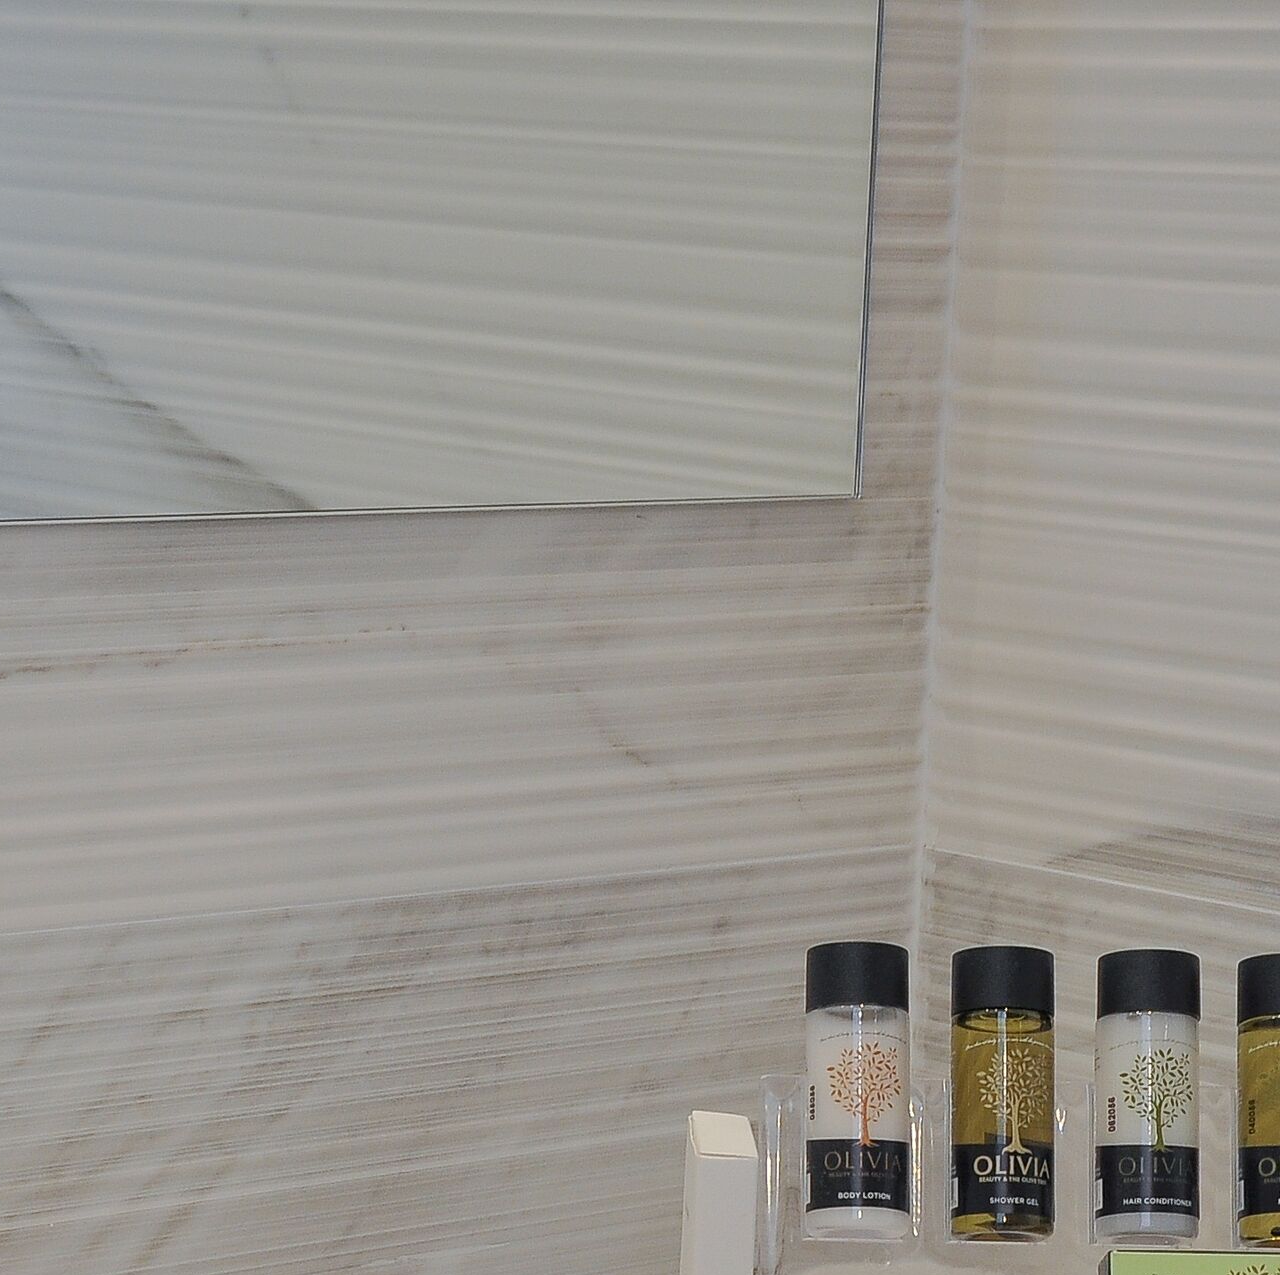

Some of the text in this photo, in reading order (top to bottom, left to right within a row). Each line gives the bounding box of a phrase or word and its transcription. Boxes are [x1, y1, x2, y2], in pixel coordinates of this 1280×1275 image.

[824, 1151, 901, 1172] OLIVIA
[973, 1155, 1051, 1180] OLIVIA
[837, 1192, 892, 1202] BODY LOTION
[989, 1197, 1040, 1207] SHOWER GEL
[1122, 1197, 1192, 1208] HAIR CONDITIONER
